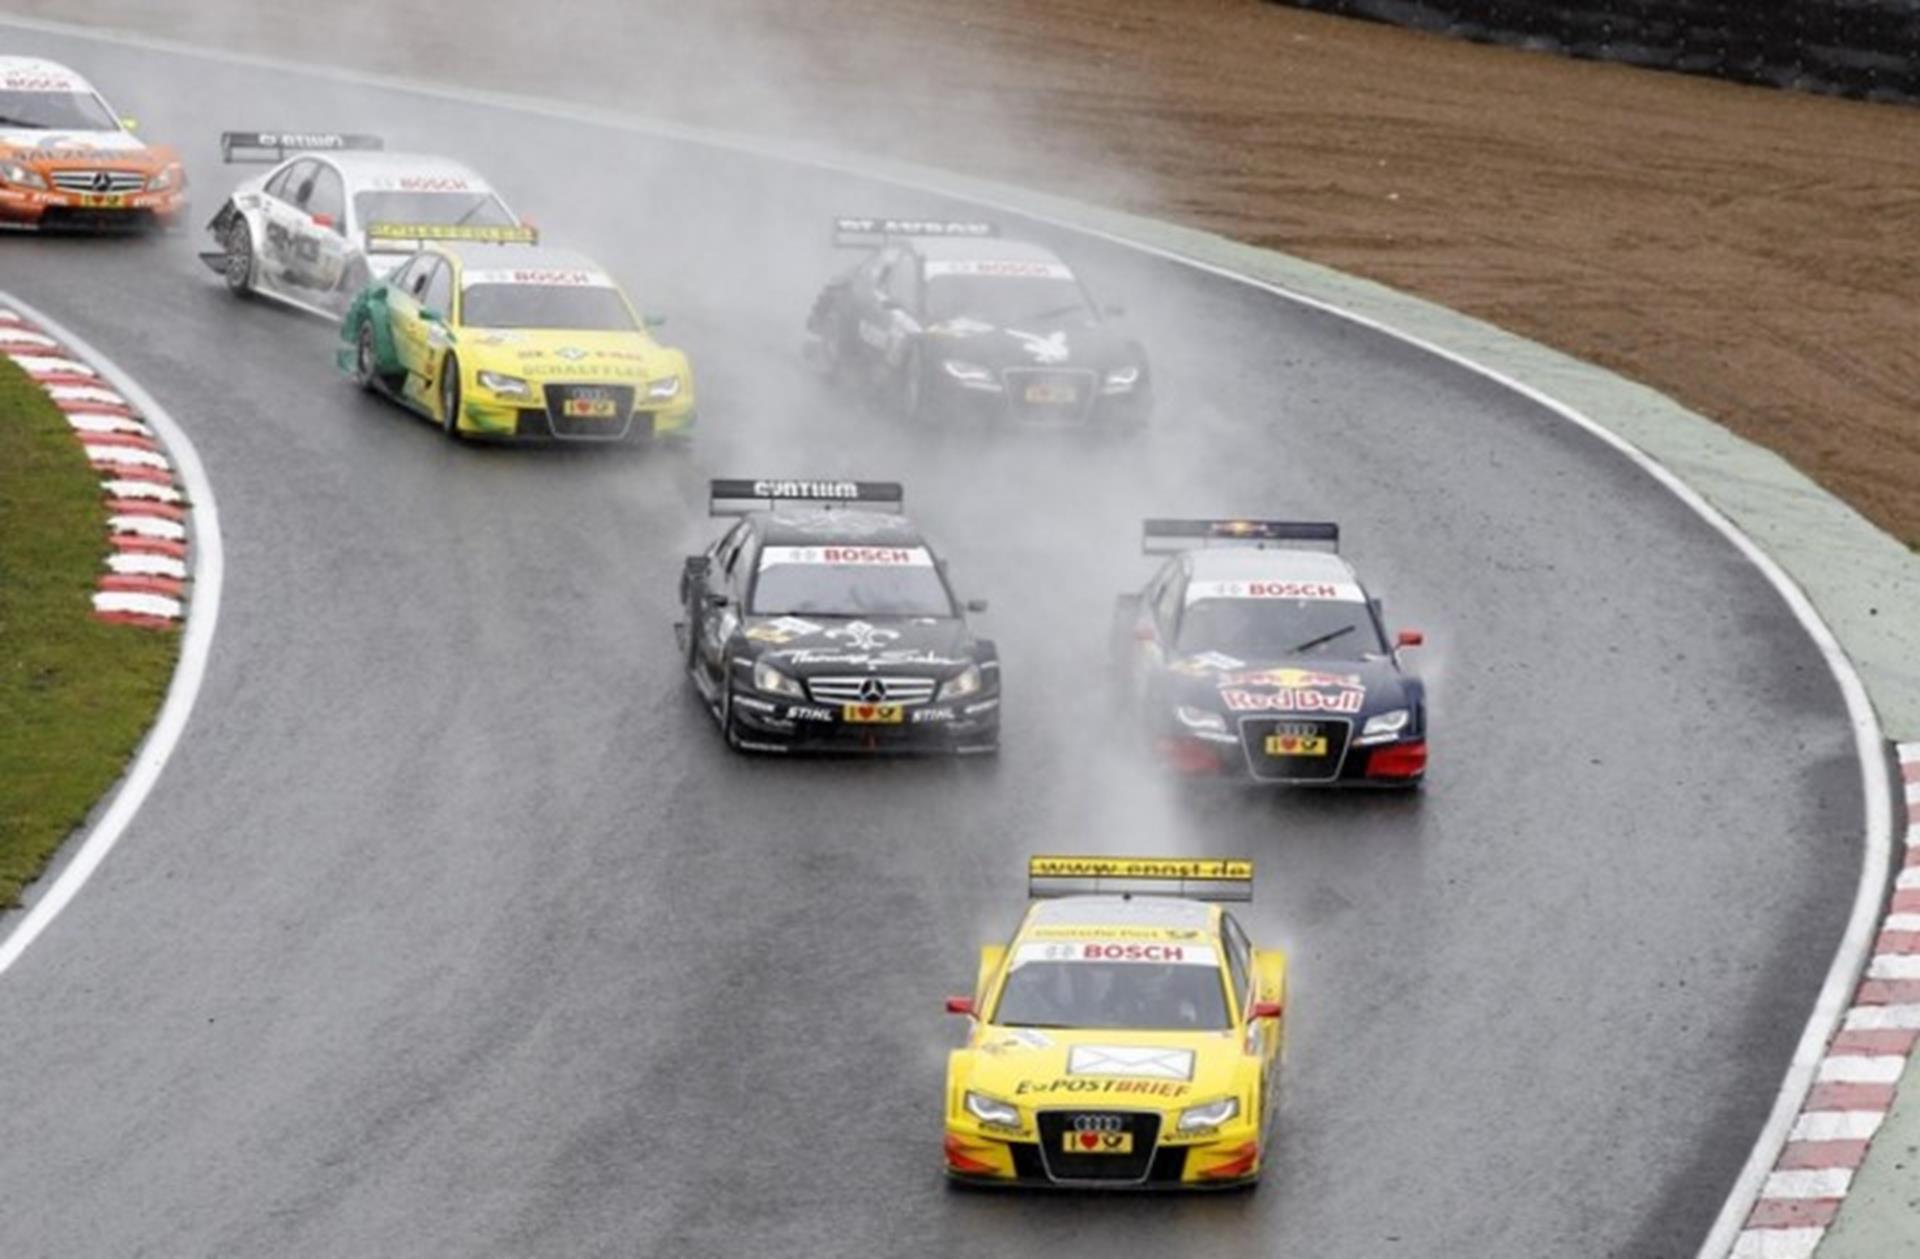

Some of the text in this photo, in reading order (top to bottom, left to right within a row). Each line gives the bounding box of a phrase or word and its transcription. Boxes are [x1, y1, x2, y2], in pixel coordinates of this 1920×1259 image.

[514, 271, 589, 284] BOSCH
[824, 549, 910, 563] BOSCH
[1249, 583, 1337, 597] BOSCH
[1221, 688, 1364, 713] Red Bull
[785, 706, 834, 721] STIHL
[1083, 944, 1184, 961] BOSCH
